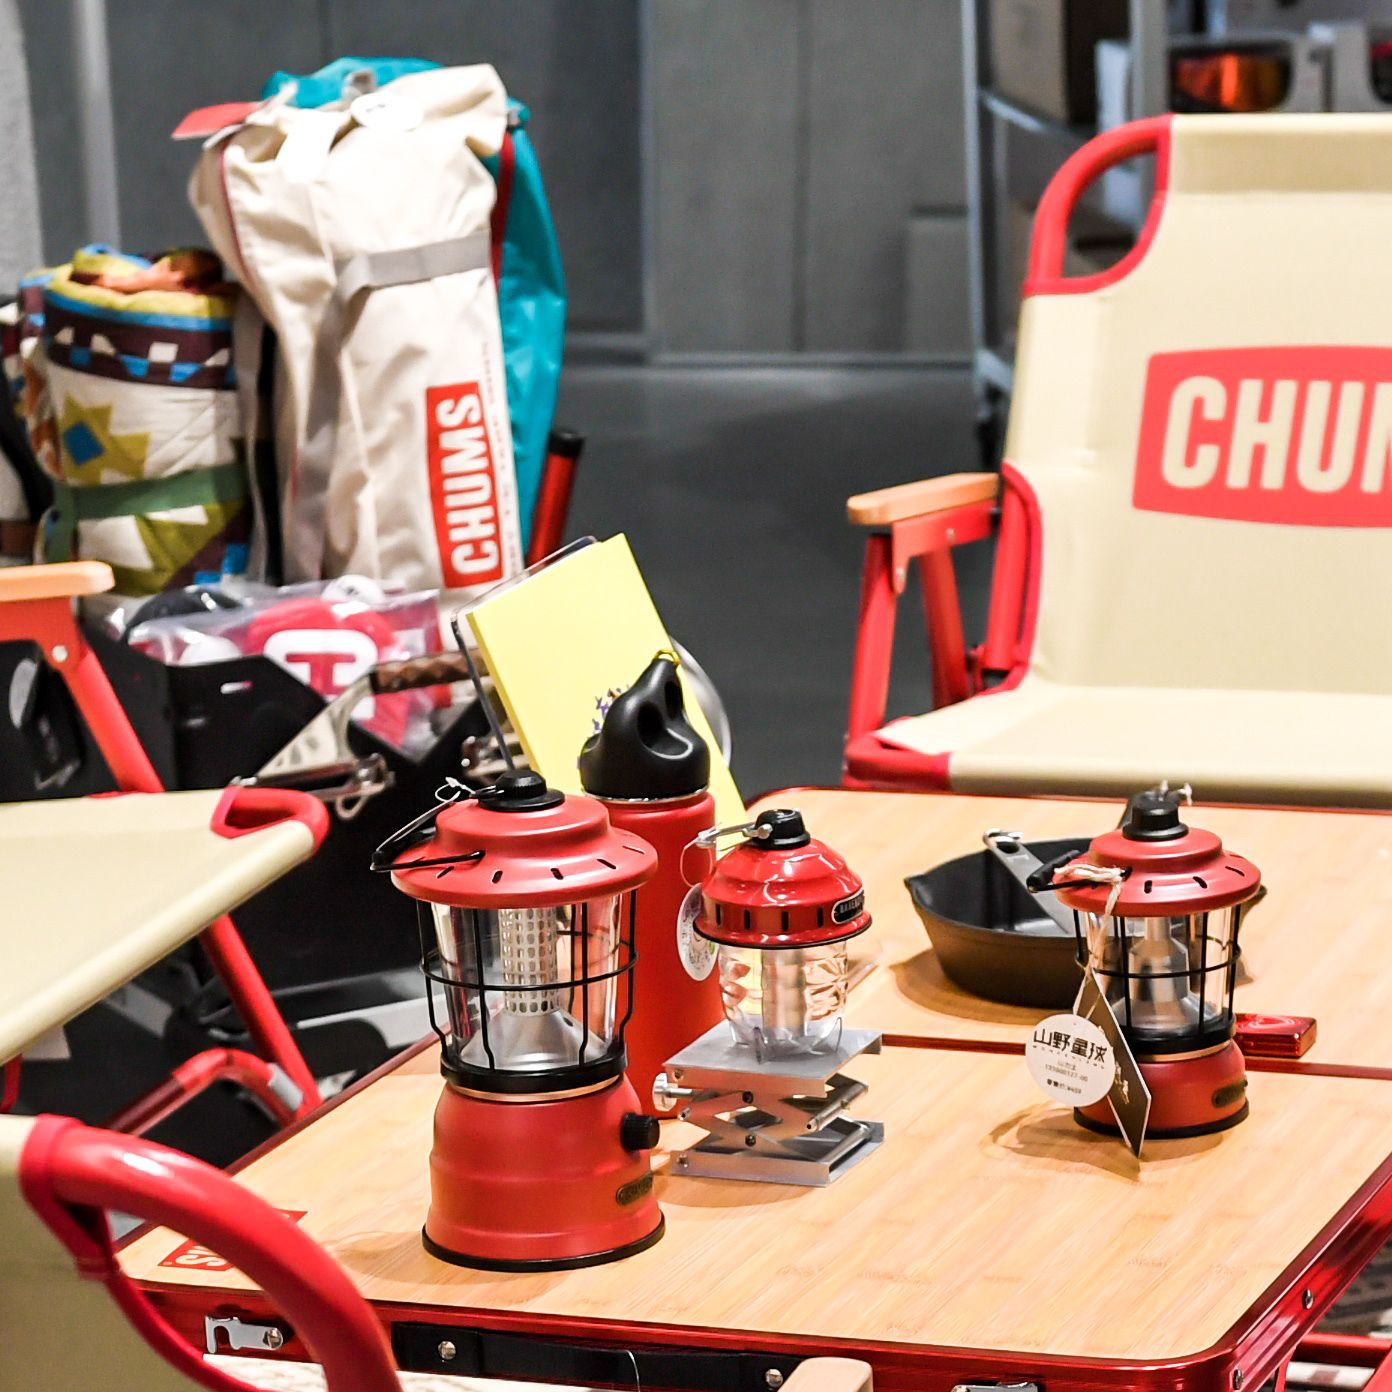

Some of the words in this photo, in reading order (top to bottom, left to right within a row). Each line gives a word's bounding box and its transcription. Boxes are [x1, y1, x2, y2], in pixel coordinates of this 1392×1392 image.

[435, 393, 501, 575] CHUMS
[1033, 1028, 1108, 1063] 山野星球
